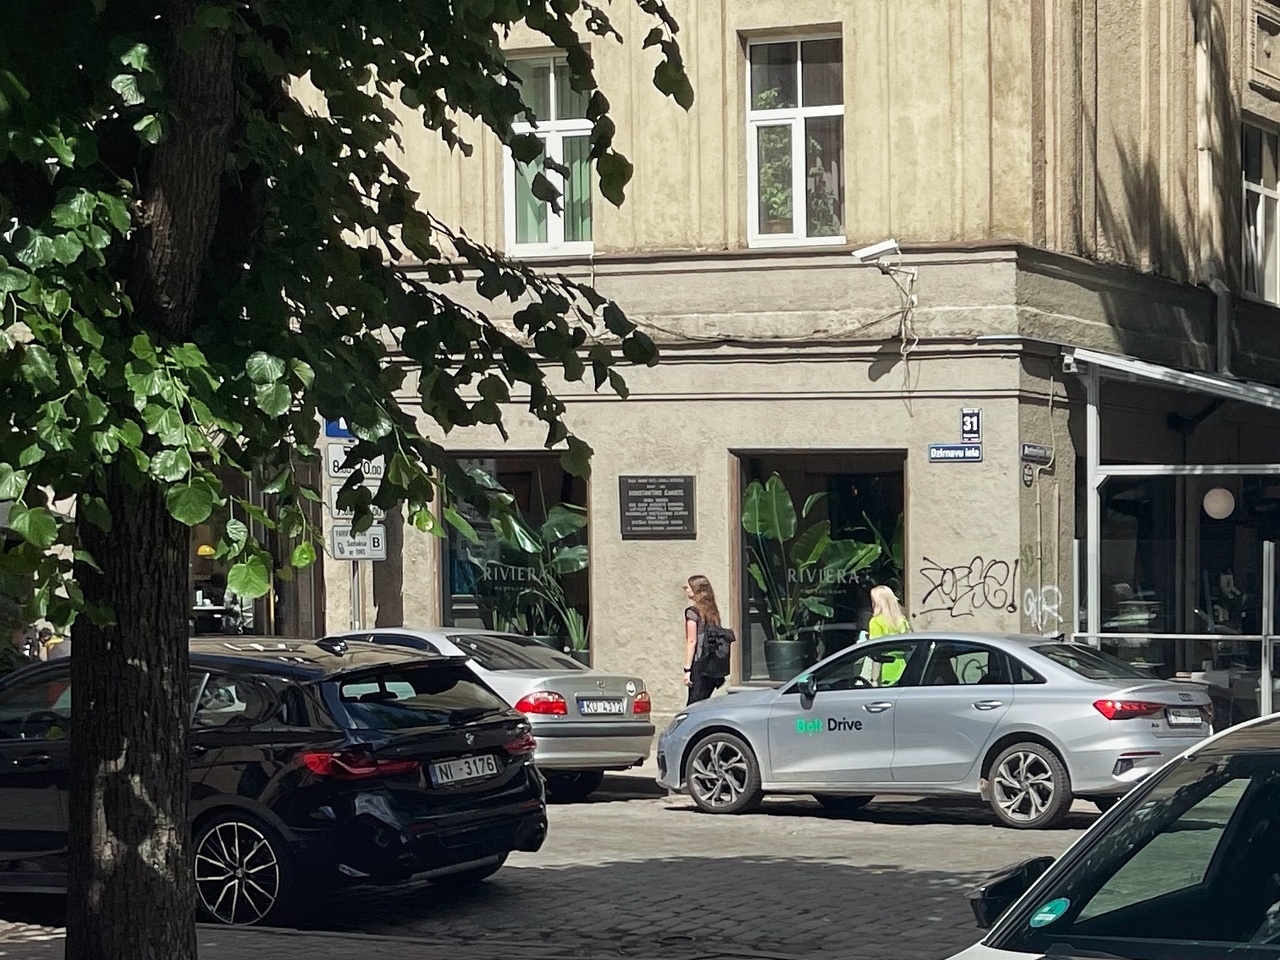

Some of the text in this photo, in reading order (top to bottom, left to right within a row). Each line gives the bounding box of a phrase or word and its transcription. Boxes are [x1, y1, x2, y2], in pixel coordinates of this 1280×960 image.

[963, 415, 978, 430] 31
[930, 447, 980, 458] Dzirnavu iela
[372, 536, 381, 548] B
[787, 568, 860, 584] RIVIERA
[827, 716, 863, 731] Drive
